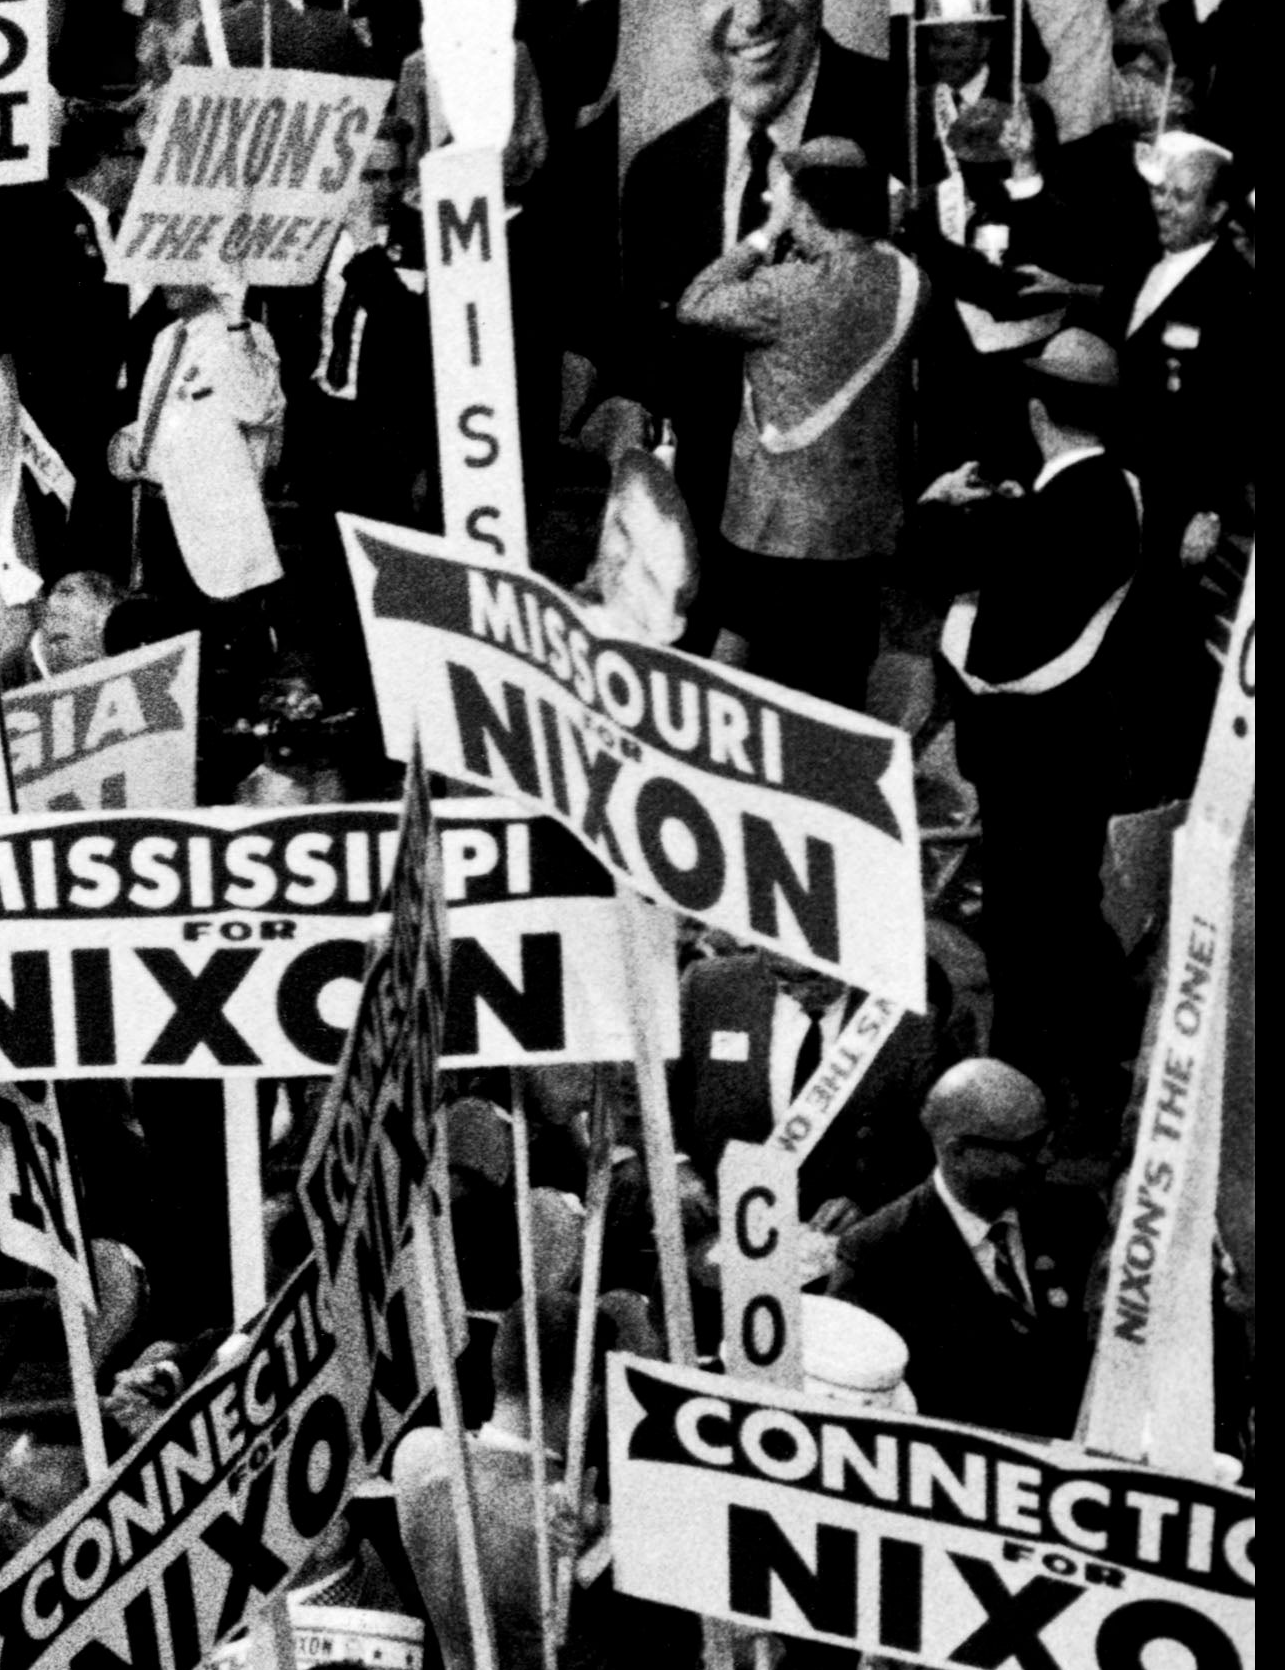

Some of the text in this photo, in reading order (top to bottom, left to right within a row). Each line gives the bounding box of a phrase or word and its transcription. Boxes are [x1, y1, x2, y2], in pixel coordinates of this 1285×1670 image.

[149, 94, 370, 194] NIXON'S
[123, 210, 345, 265] THE ONE!
[467, 568, 785, 785] MISSOURI
[445, 659, 842, 966] NIXON
[182, 917, 297, 945] FOR
[1113, 912, 1220, 1349] NIXON'S THE ONE!
[19, 1290, 327, 1643] CONNECTI
[999, 1540, 1133, 1589] FOR
